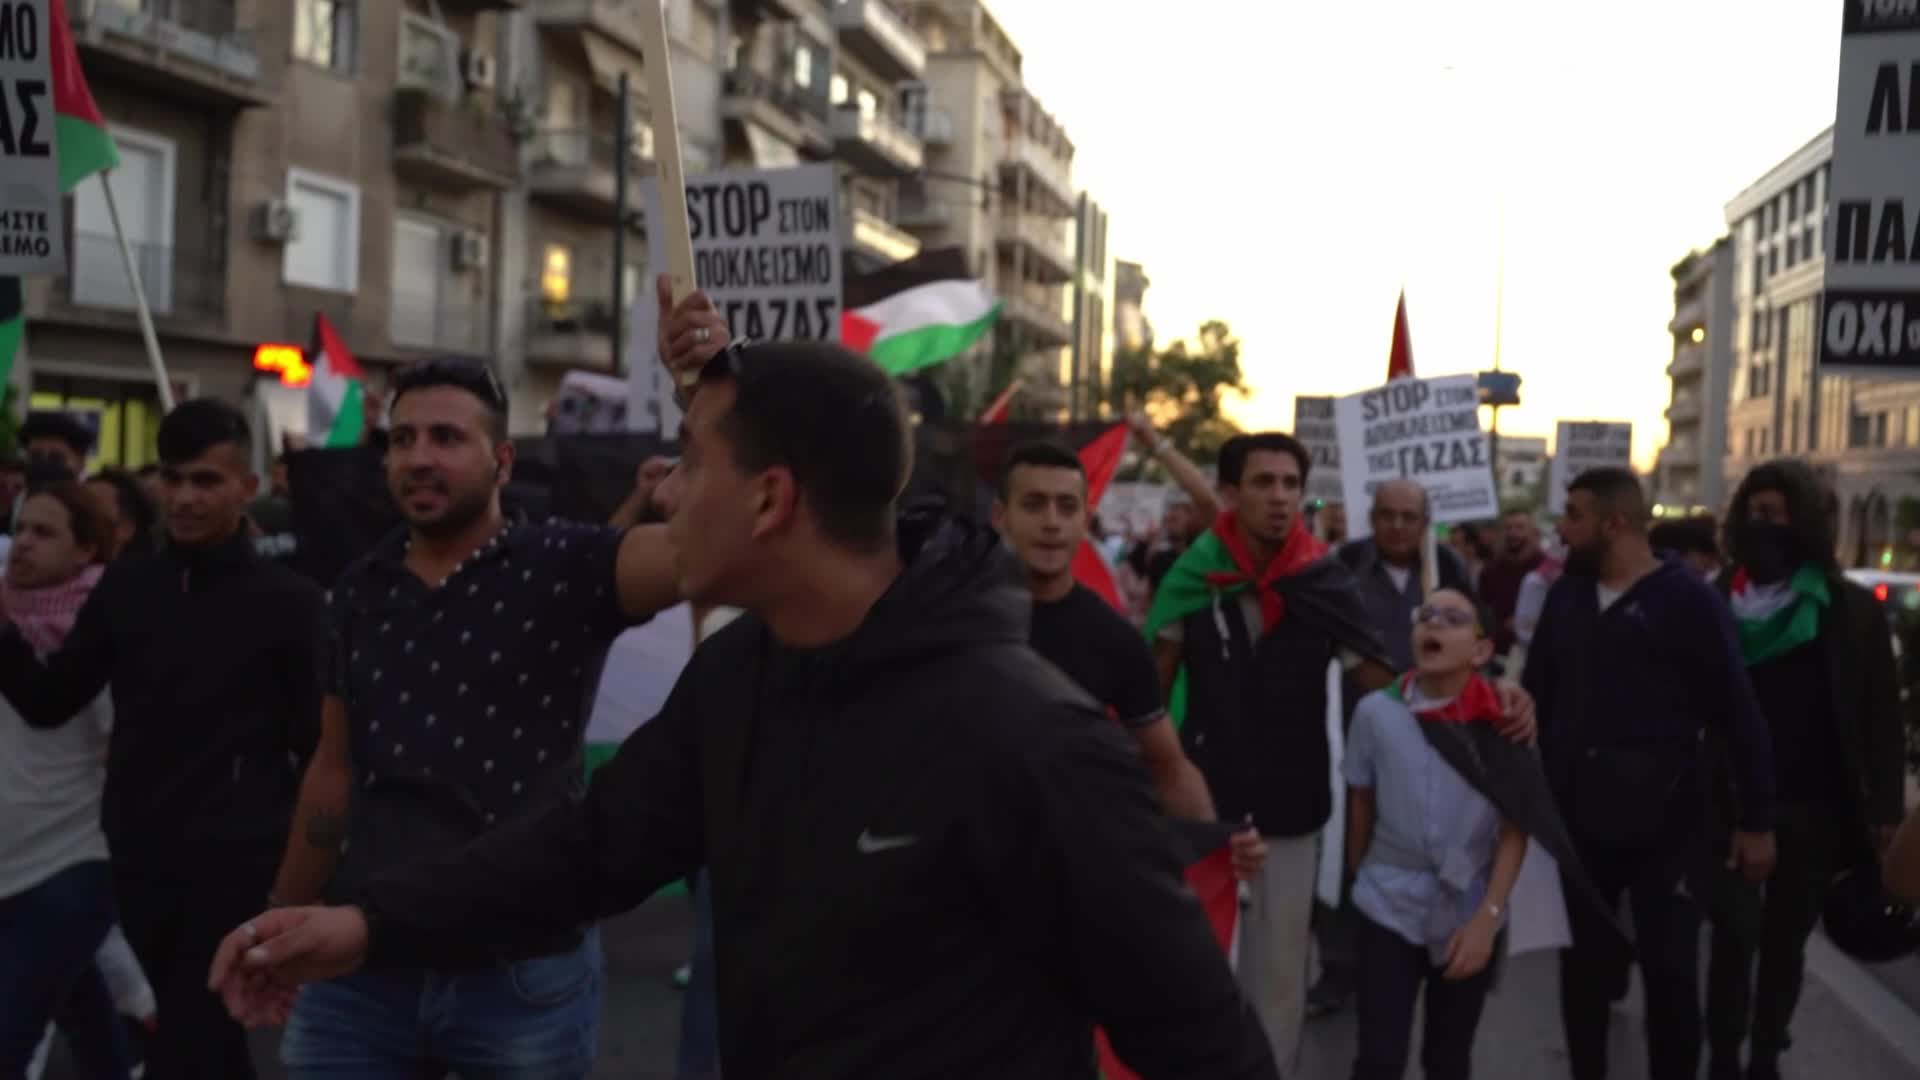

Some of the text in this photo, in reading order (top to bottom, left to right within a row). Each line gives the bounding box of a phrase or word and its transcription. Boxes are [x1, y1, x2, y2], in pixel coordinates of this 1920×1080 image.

[686, 181, 829, 239] STOP ΣΤΟΝ
[0, 235, 50, 257] ΕΜΟ
[696, 244, 831, 288] ΠΟΚΛΕΙΣΜΟ
[1826, 301, 1904, 355] ΟΧΙ
[1362, 382, 1429, 421] STOP
[1398, 438, 1486, 477] ΓΑΖΑΣ
